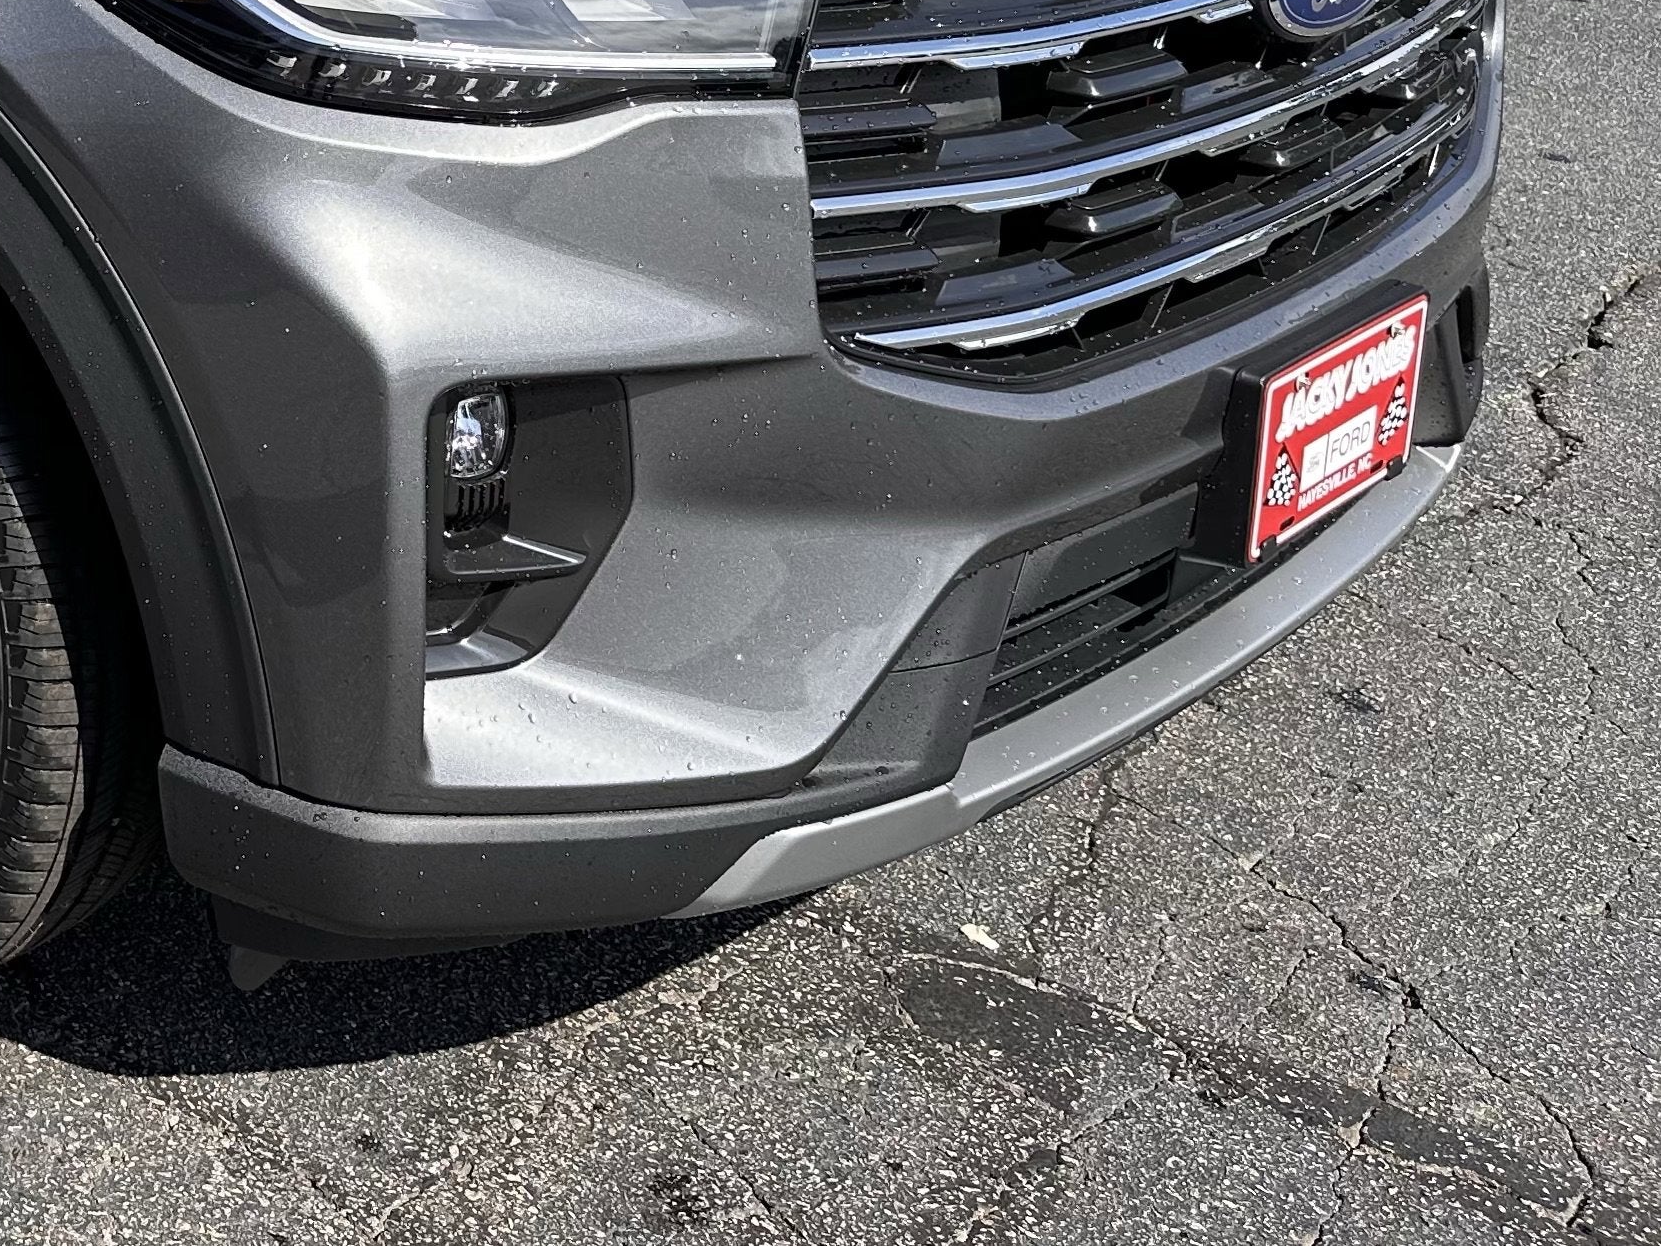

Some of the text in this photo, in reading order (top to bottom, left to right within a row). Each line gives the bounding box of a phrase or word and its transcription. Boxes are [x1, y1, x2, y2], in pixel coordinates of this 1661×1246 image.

[1275, 325, 1416, 443] JACKY JONES
[1330, 420, 1371, 463] FORD
[1357, 452, 1374, 475] NC
